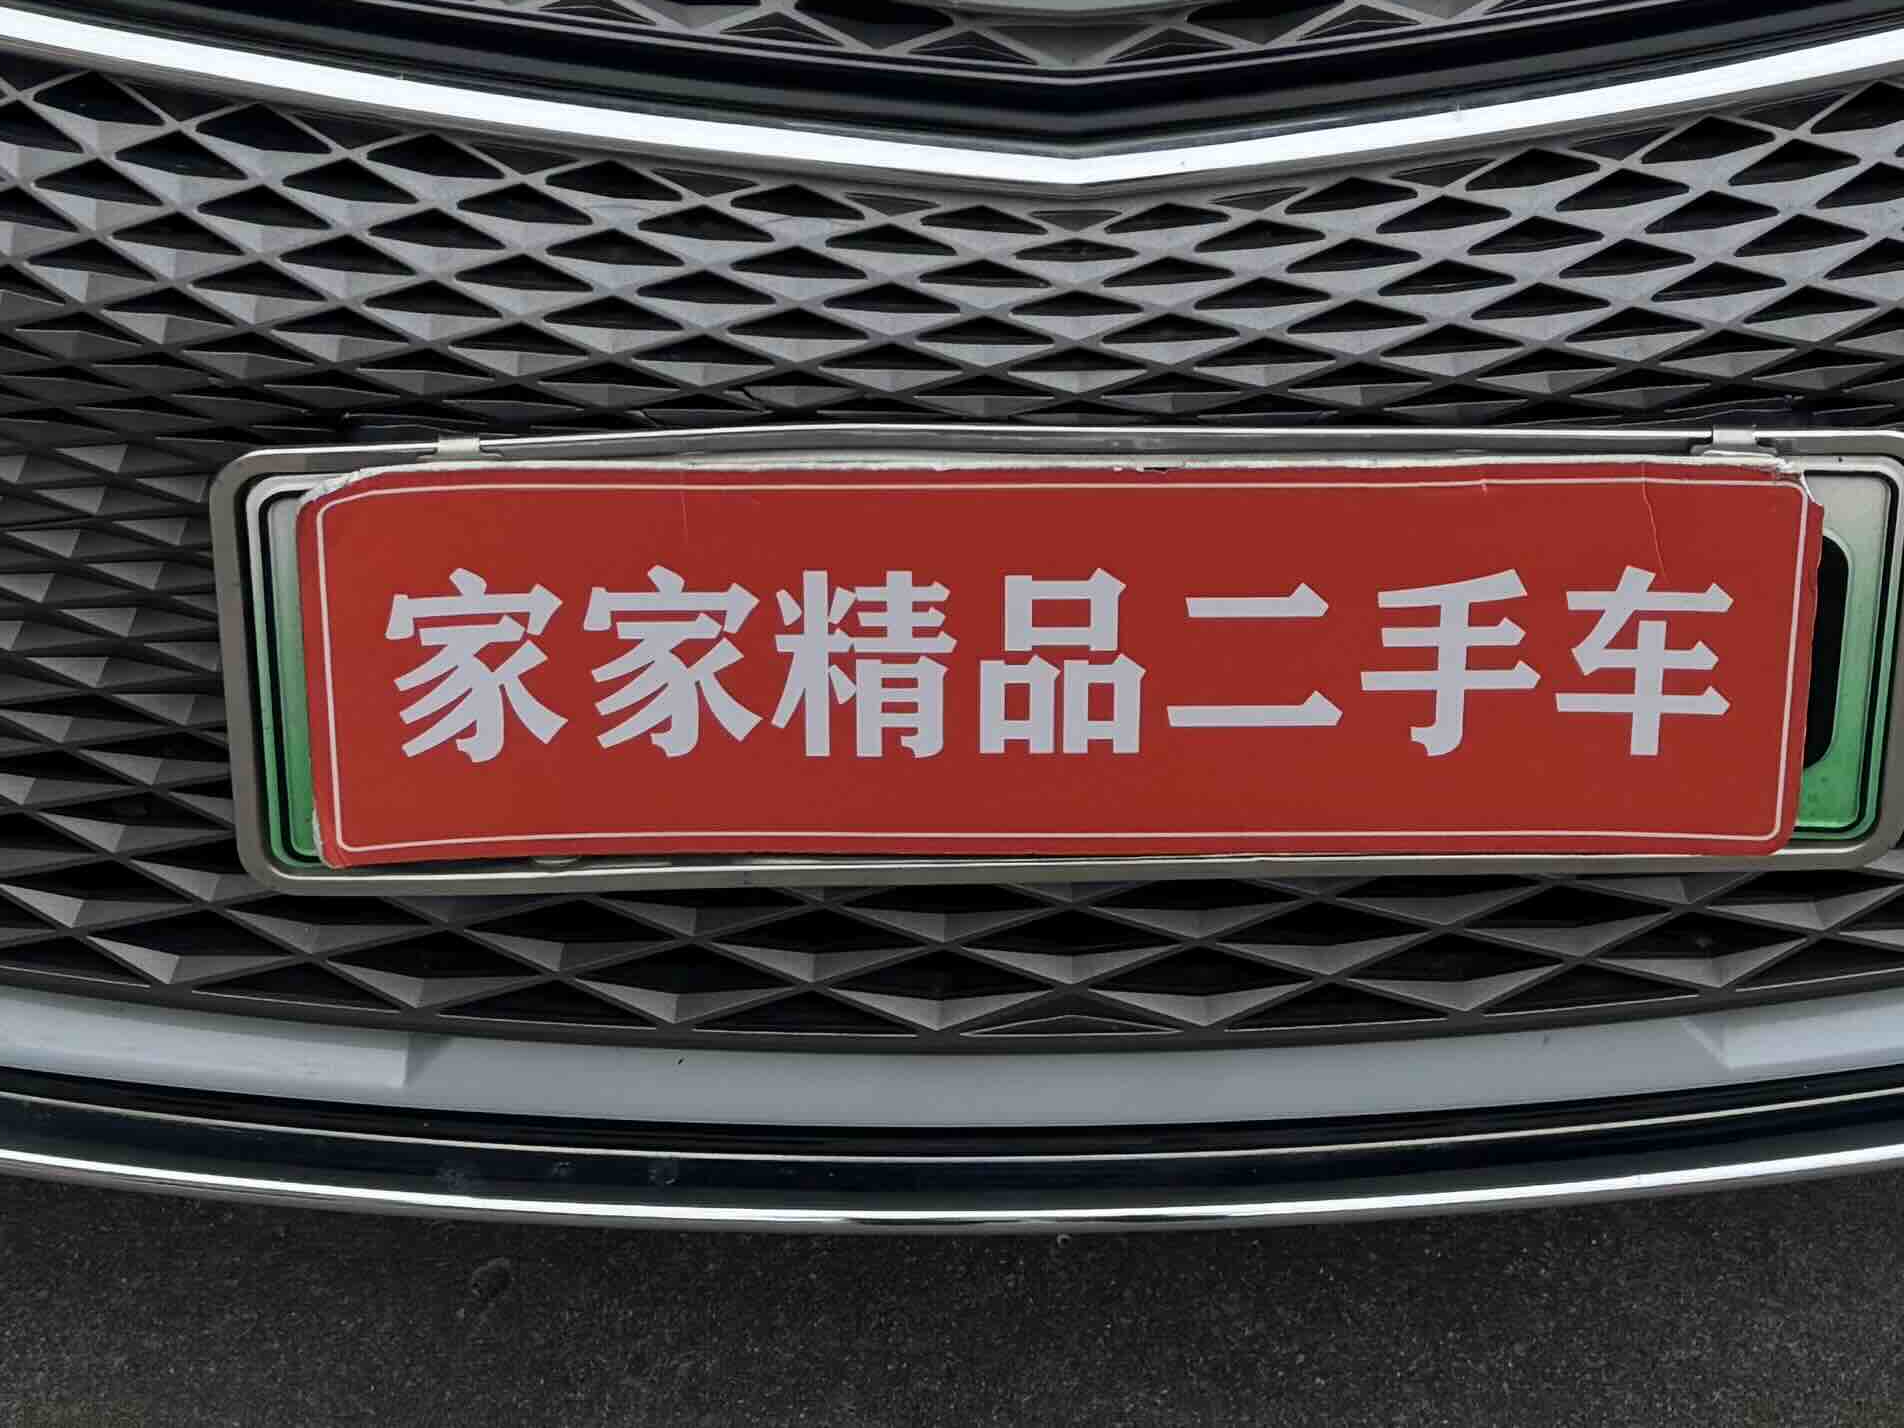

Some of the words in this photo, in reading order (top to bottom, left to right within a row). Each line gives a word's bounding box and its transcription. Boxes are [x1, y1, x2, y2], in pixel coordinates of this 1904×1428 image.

[384, 564, 1734, 763] 家家精品二手车
